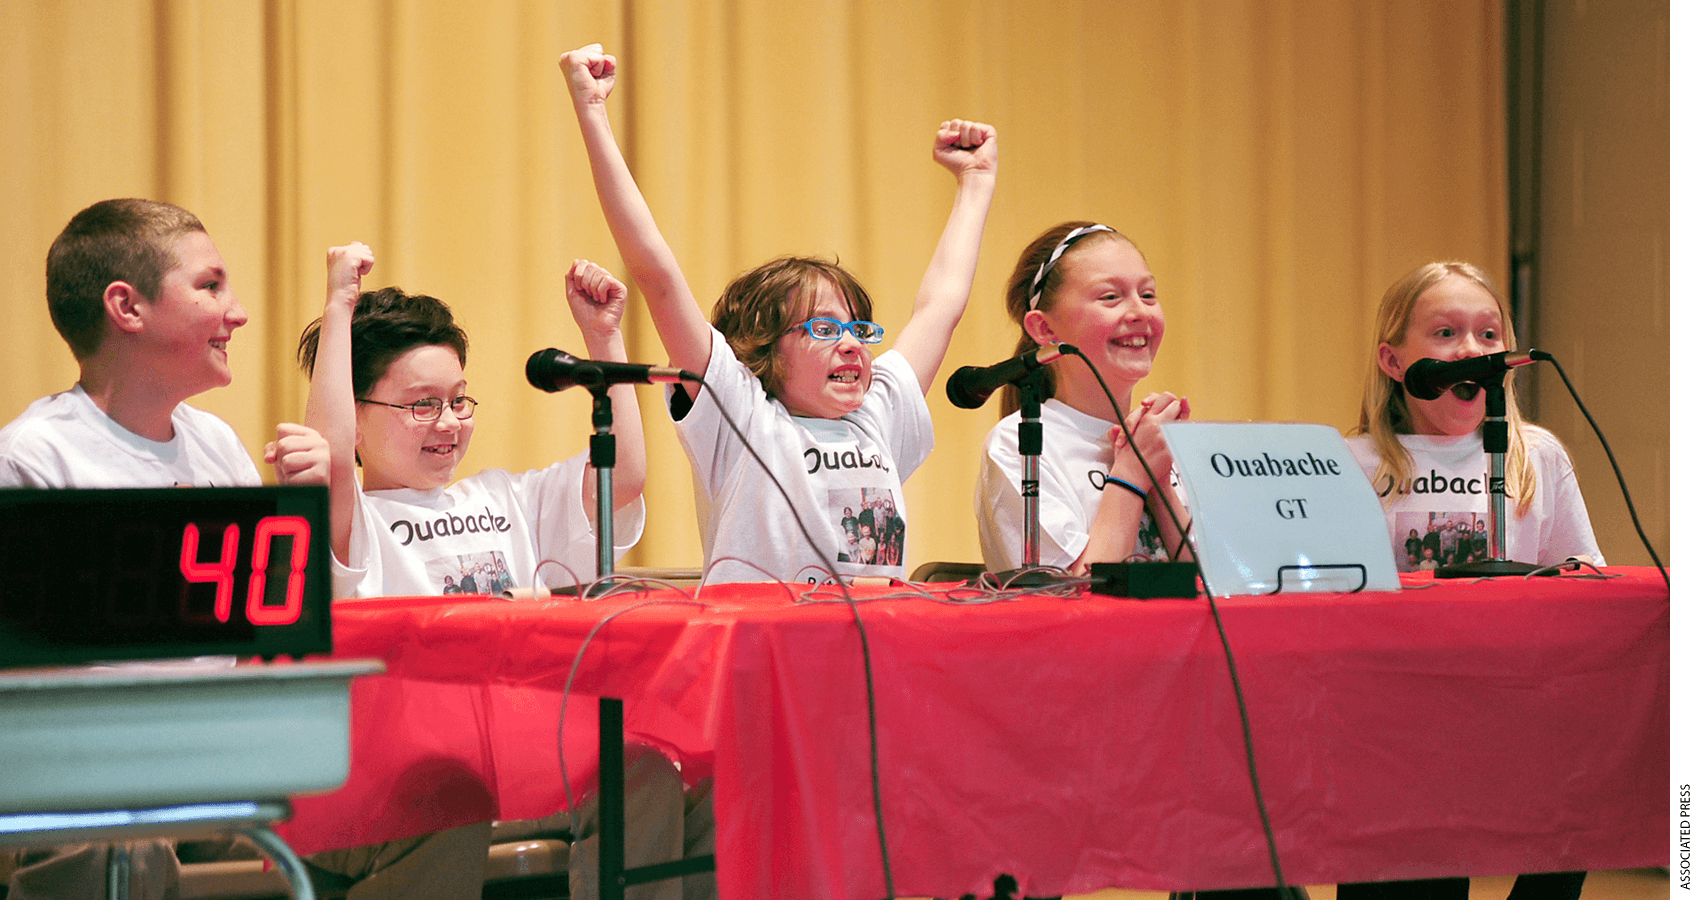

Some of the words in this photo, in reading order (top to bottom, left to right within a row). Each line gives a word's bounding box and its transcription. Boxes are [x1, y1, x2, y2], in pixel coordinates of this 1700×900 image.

[1210, 452, 1341, 478] Ouabache
[1275, 498, 1308, 520] GT
[180, 515, 311, 626] 40
